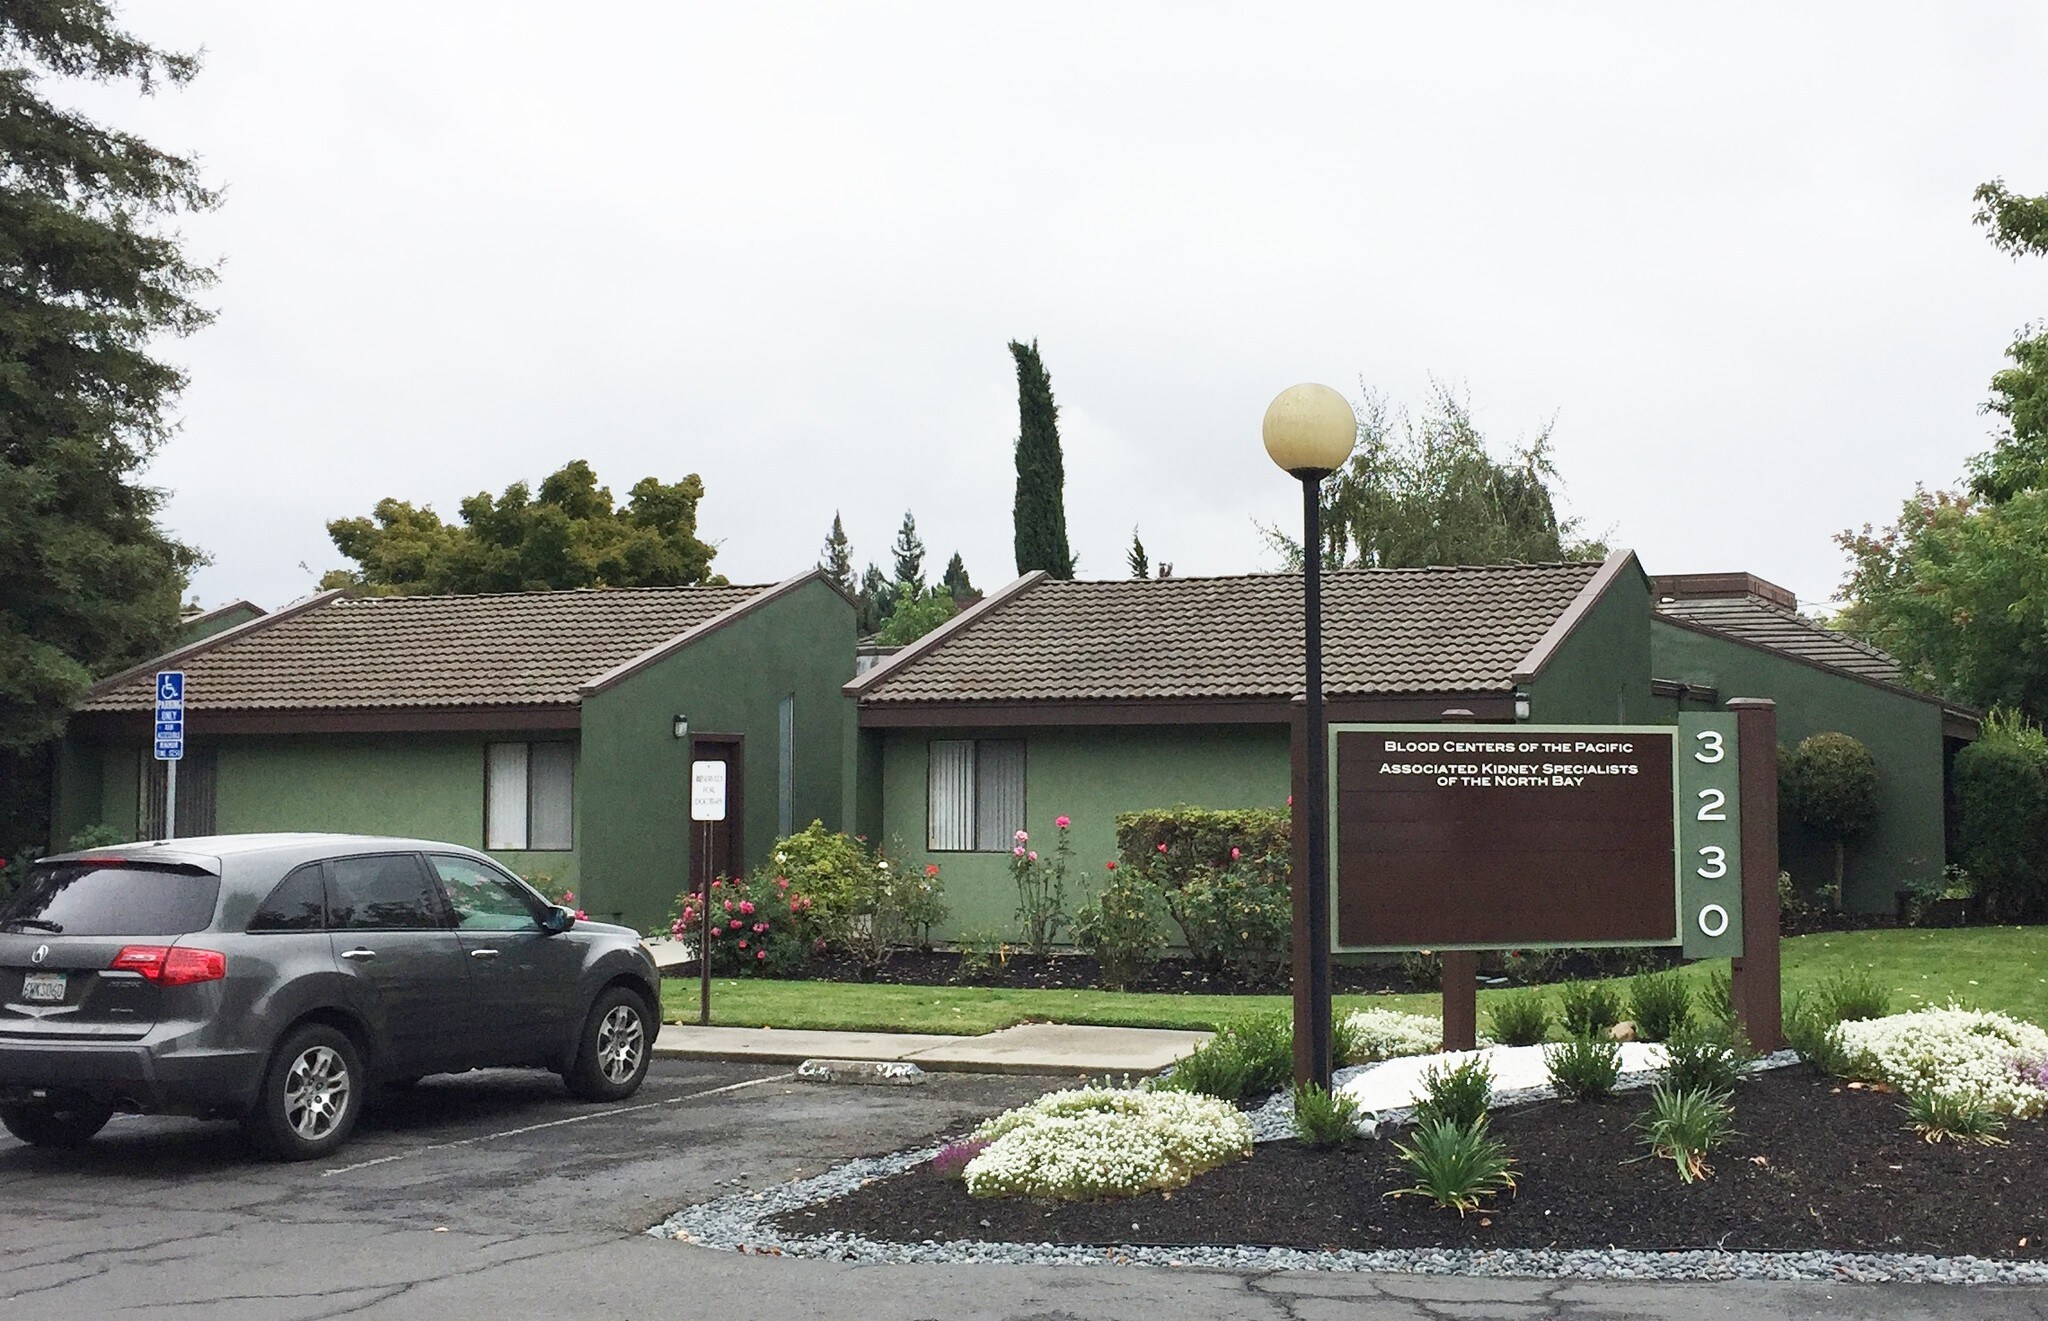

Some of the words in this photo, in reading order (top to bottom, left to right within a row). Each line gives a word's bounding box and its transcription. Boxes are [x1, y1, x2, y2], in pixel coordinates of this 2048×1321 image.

[1384, 740, 1440, 753] BLOOD
[1443, 740, 1516, 753] CENTERS
[1518, 742, 1540, 753] OF
[1541, 742, 1572, 753] THE
[1574, 741, 1634, 754] PACIFIC
[1378, 762, 1479, 775] ASSOCIATED
[1481, 763, 1540, 775] KIDNEY
[1541, 763, 1639, 775] SPECIALISTS
[1436, 776, 1458, 787] OF
[1460, 776, 1492, 787] THE
[1494, 775, 1549, 787] NORTH
[1551, 775, 1585, 787] BAY
